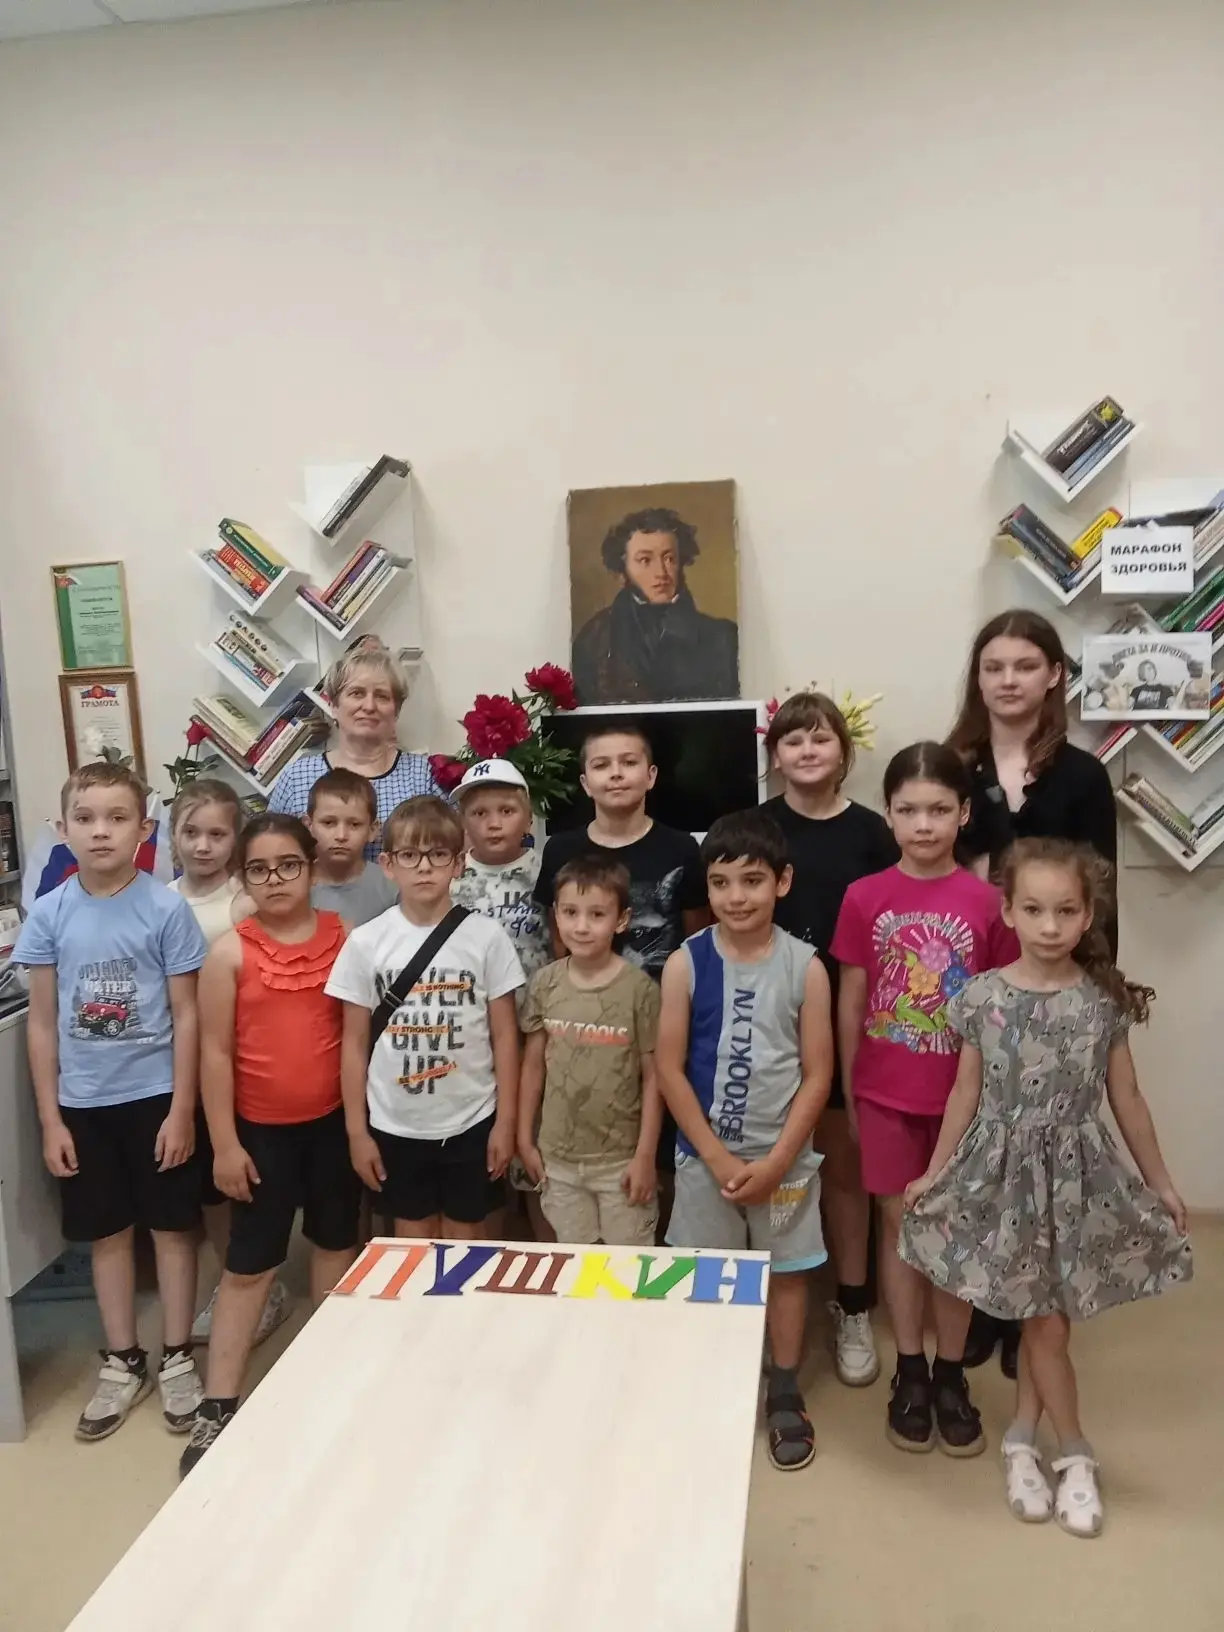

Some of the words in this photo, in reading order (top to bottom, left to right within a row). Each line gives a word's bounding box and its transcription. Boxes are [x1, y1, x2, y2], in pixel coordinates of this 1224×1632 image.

[1111, 543, 1182, 556] МАРАФОН
[1111, 561, 1187, 576] ЗДОРОВЬЯ
[81, 699, 120, 708] ГРАМОТА
[391, 1010, 465, 1051] GIVE
[573, 1021, 629, 1042] TOOLS
[403, 1054, 450, 1095] UP
[718, 988, 756, 1134] BROOKLYN
[324, 1241, 770, 1306] ПУШКИН
